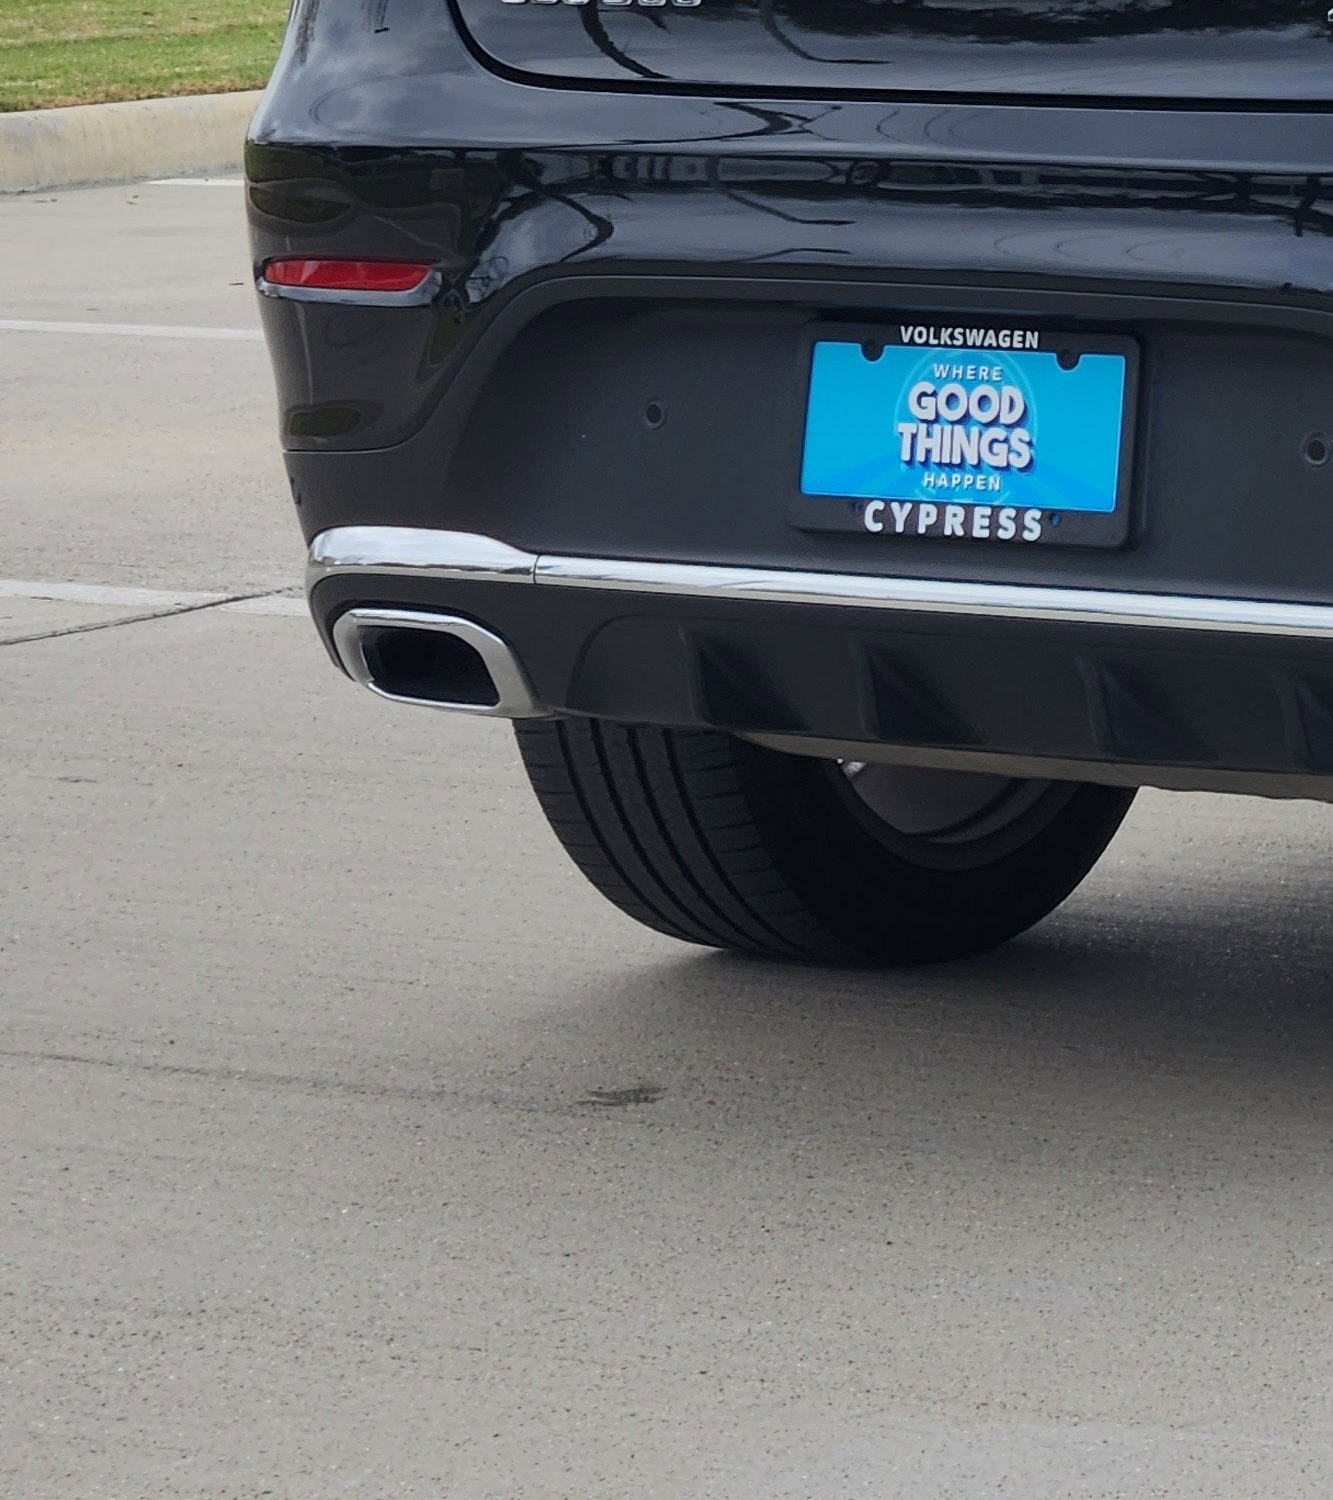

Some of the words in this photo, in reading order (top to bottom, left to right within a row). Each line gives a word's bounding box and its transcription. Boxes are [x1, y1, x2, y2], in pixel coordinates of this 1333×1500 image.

[900, 324, 1039, 349] VOLKSWAGEN
[933, 363, 1004, 382] WHERE
[908, 381, 1027, 426] GOOD
[898, 422, 1034, 470] THINGS
[923, 472, 1002, 492] HAPPEN
[863, 499, 1044, 542] CYPRESS
